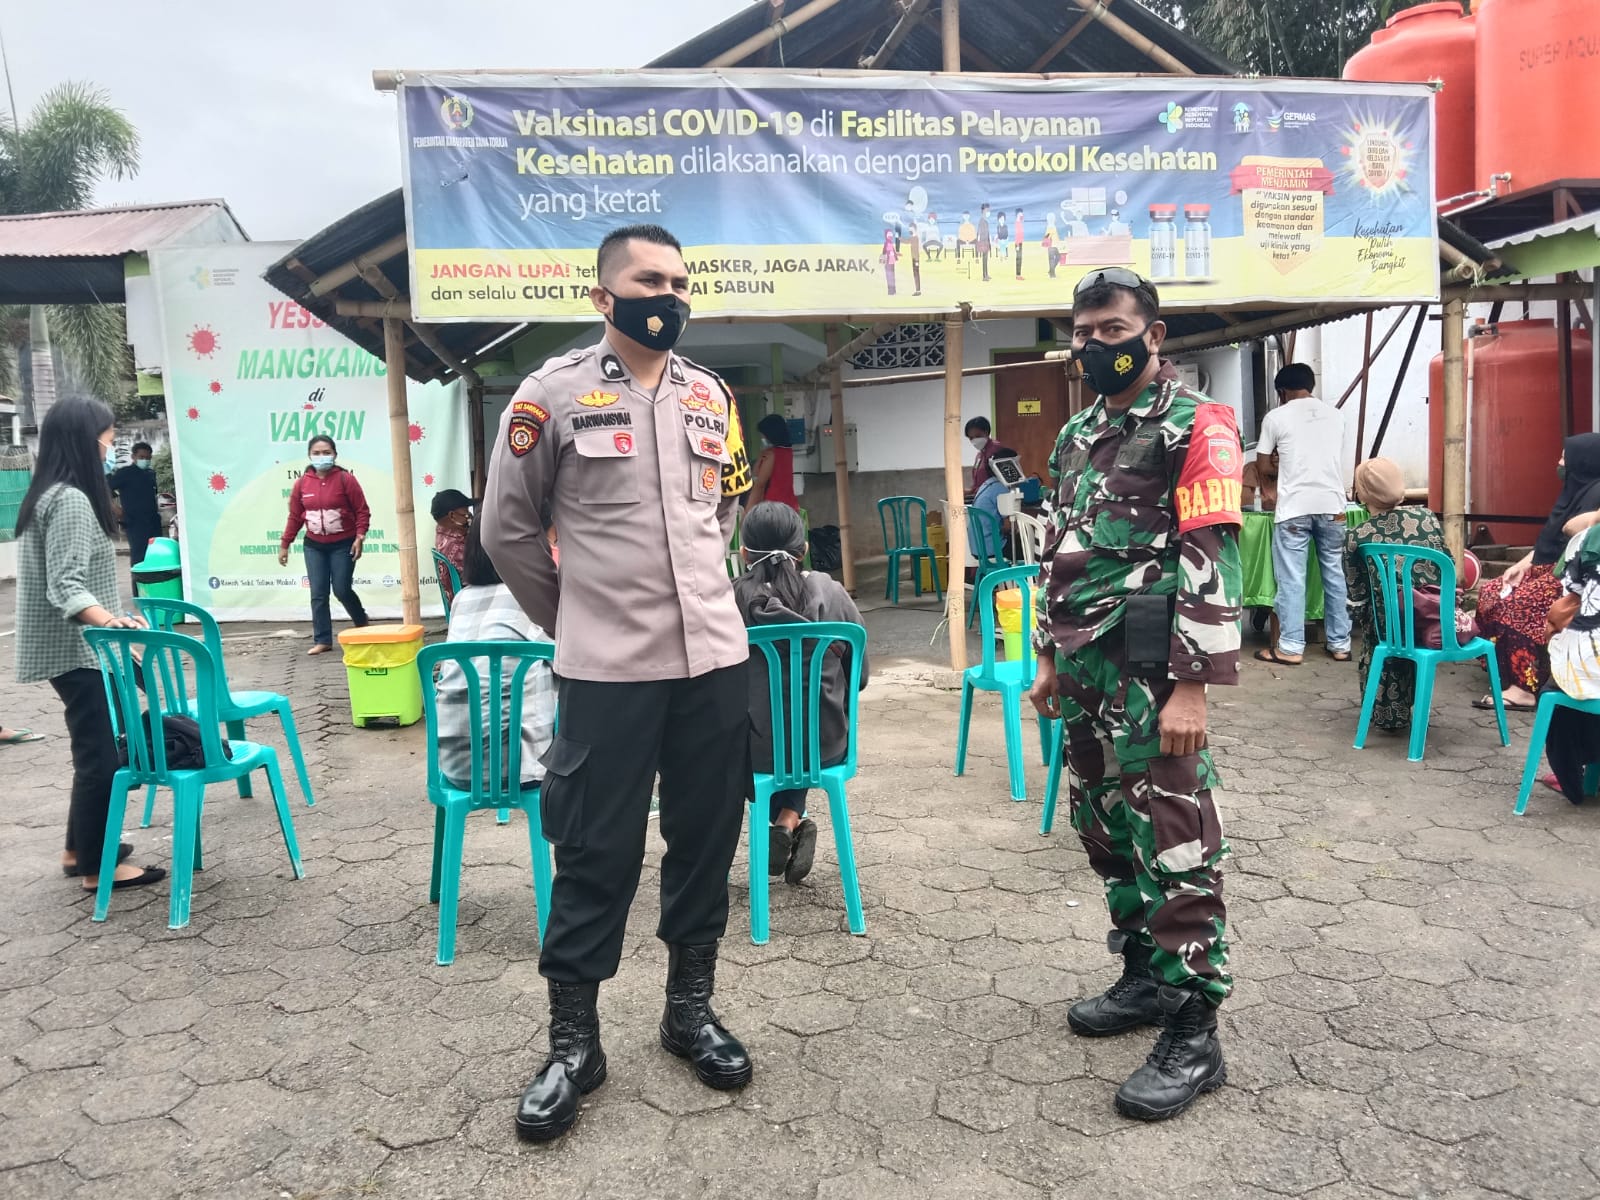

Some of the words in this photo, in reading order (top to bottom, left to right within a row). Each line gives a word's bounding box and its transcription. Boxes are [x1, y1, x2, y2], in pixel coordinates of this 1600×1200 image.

[1283, 112, 1317, 121] GERMAS
[512, 108, 657, 137] Vaksinasi
[662, 109, 804, 137] COVID-19
[810, 109, 834, 137] di
[841, 109, 955, 138] Fasilitas
[961, 110, 1101, 142] Pelayanan
[516, 147, 674, 175] Kesehatan
[680, 145, 848, 175] dilaksanakan
[854, 147, 952, 181] dengan
[958, 144, 1076, 173] Protokol
[1082, 145, 1217, 172] Kesehatan
[1256, 166, 1313, 179] PEMERINTAH
[1261, 176, 1309, 189] MENJAMIN
[518, 192, 587, 221] yang
[594, 185, 661, 213] ketat
[1292, 194, 1312, 203] yang
[1283, 213, 1314, 221] standar
[1296, 222, 1313, 231] dan
[1353, 217, 1403, 239] Kesehatan
[1290, 243, 1311, 252] yang
[1357, 248, 1394, 262] Ekonomi
[430, 263, 512, 279] JANGAN
[518, 263, 570, 278] LUPA!
[576, 265, 597, 278] tet
[684, 259, 758, 276] MASKER,
[763, 259, 810, 273] JAGA
[814, 258, 875, 274] JARAK,
[1371, 256, 1406, 275] Bangkit
[431, 285, 463, 301] dan
[468, 285, 516, 300] selalu
[522, 285, 564, 300] CUCI
[570, 285, 590, 299] TA
[690, 281, 707, 295] AI
[714, 280, 775, 295] SABUN
[308, 387, 325, 401] di
[270, 410, 366, 441] VAKSIN
[684, 413, 724, 435] POLRI
